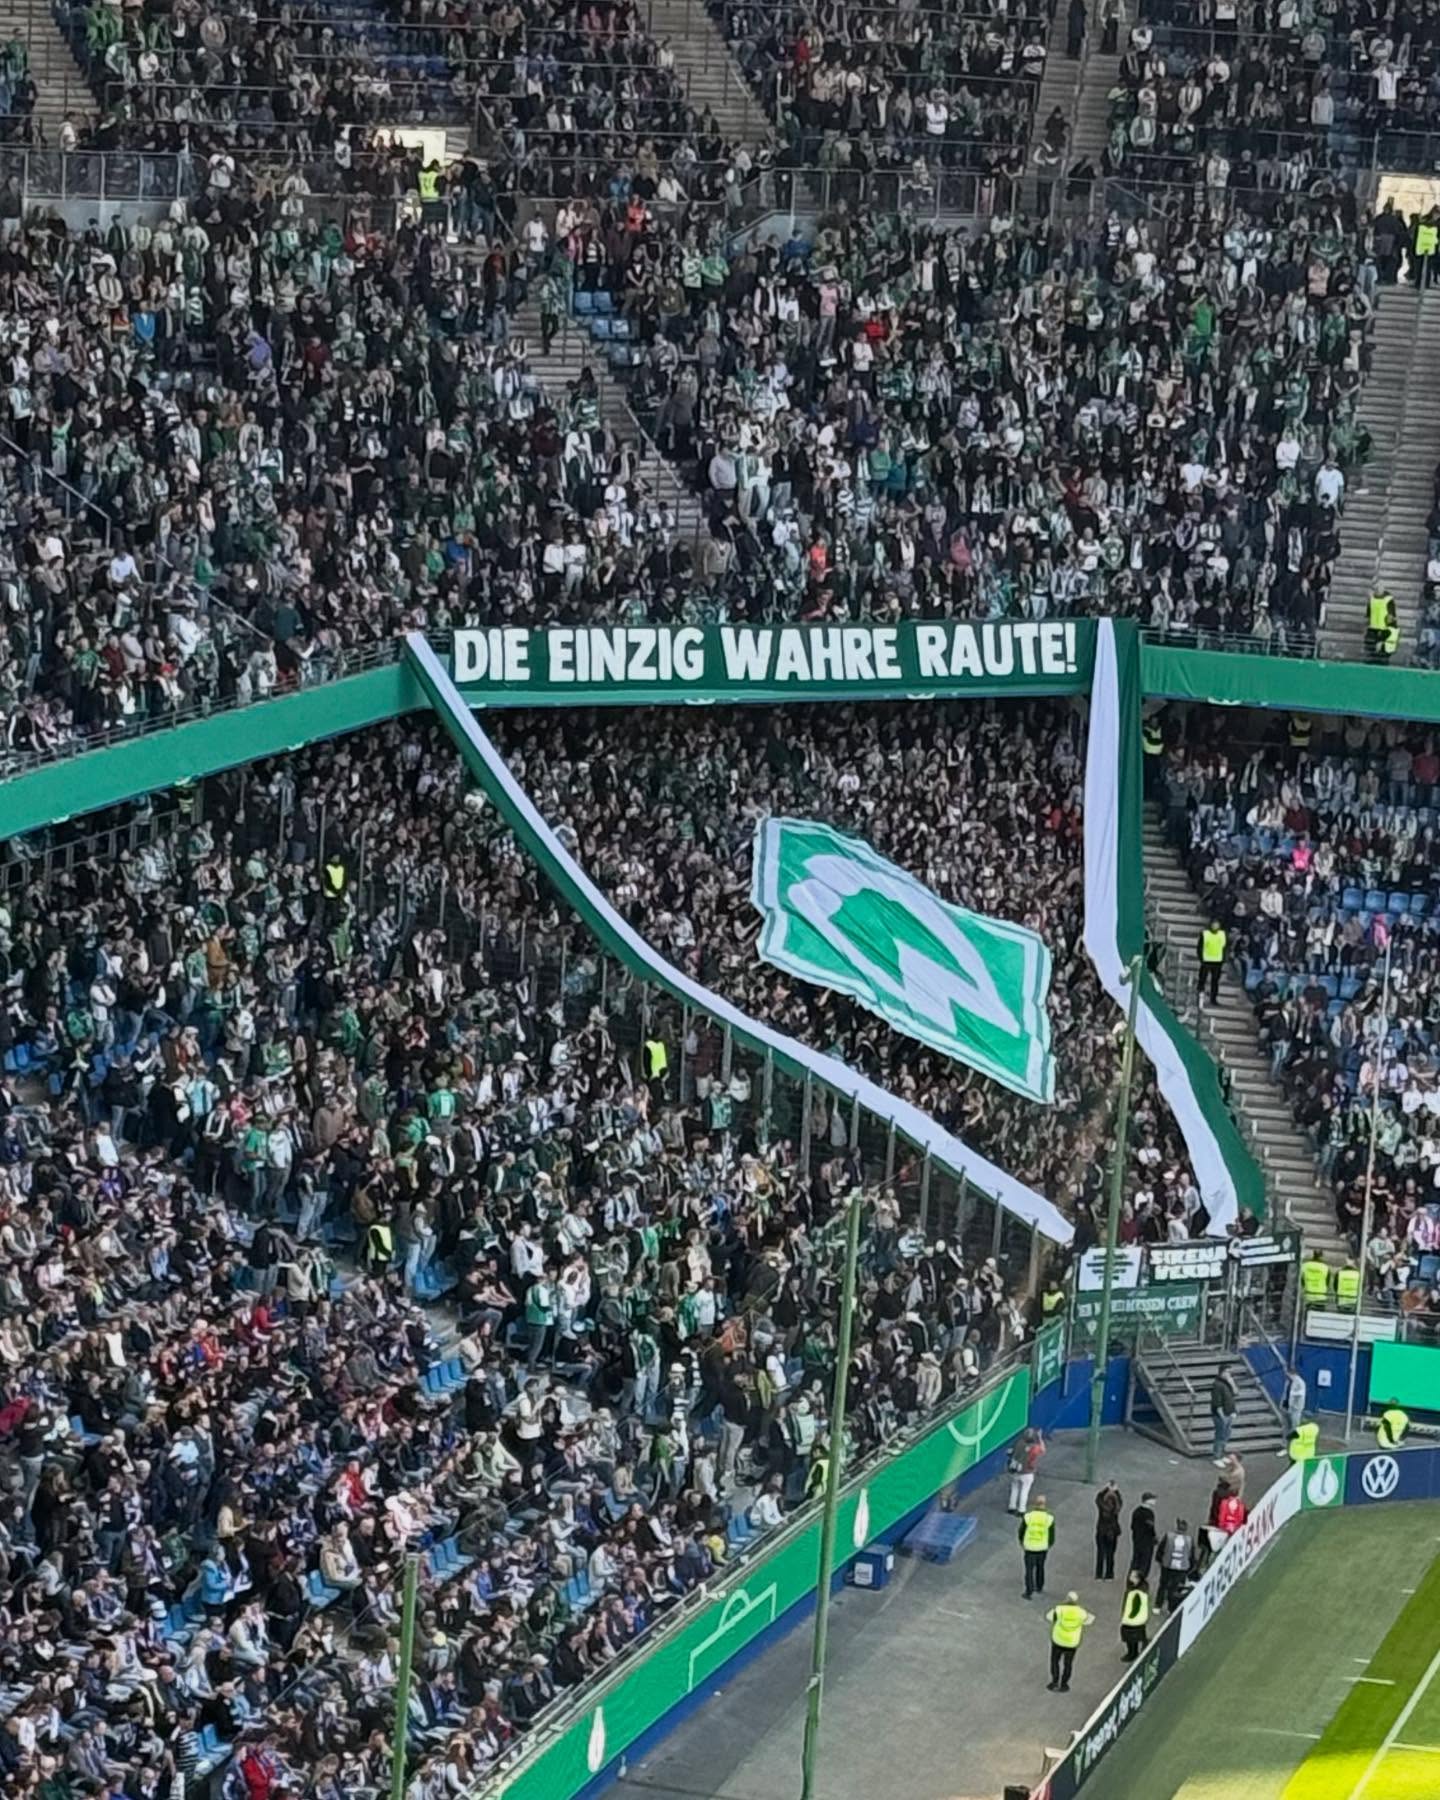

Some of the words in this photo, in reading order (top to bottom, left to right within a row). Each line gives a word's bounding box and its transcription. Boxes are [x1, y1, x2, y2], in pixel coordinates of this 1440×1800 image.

[454, 628, 530, 683] DIE
[548, 627, 704, 682] EINZIG
[720, 627, 901, 681] WAHRE
[916, 622, 1077, 677] RAUTE!
